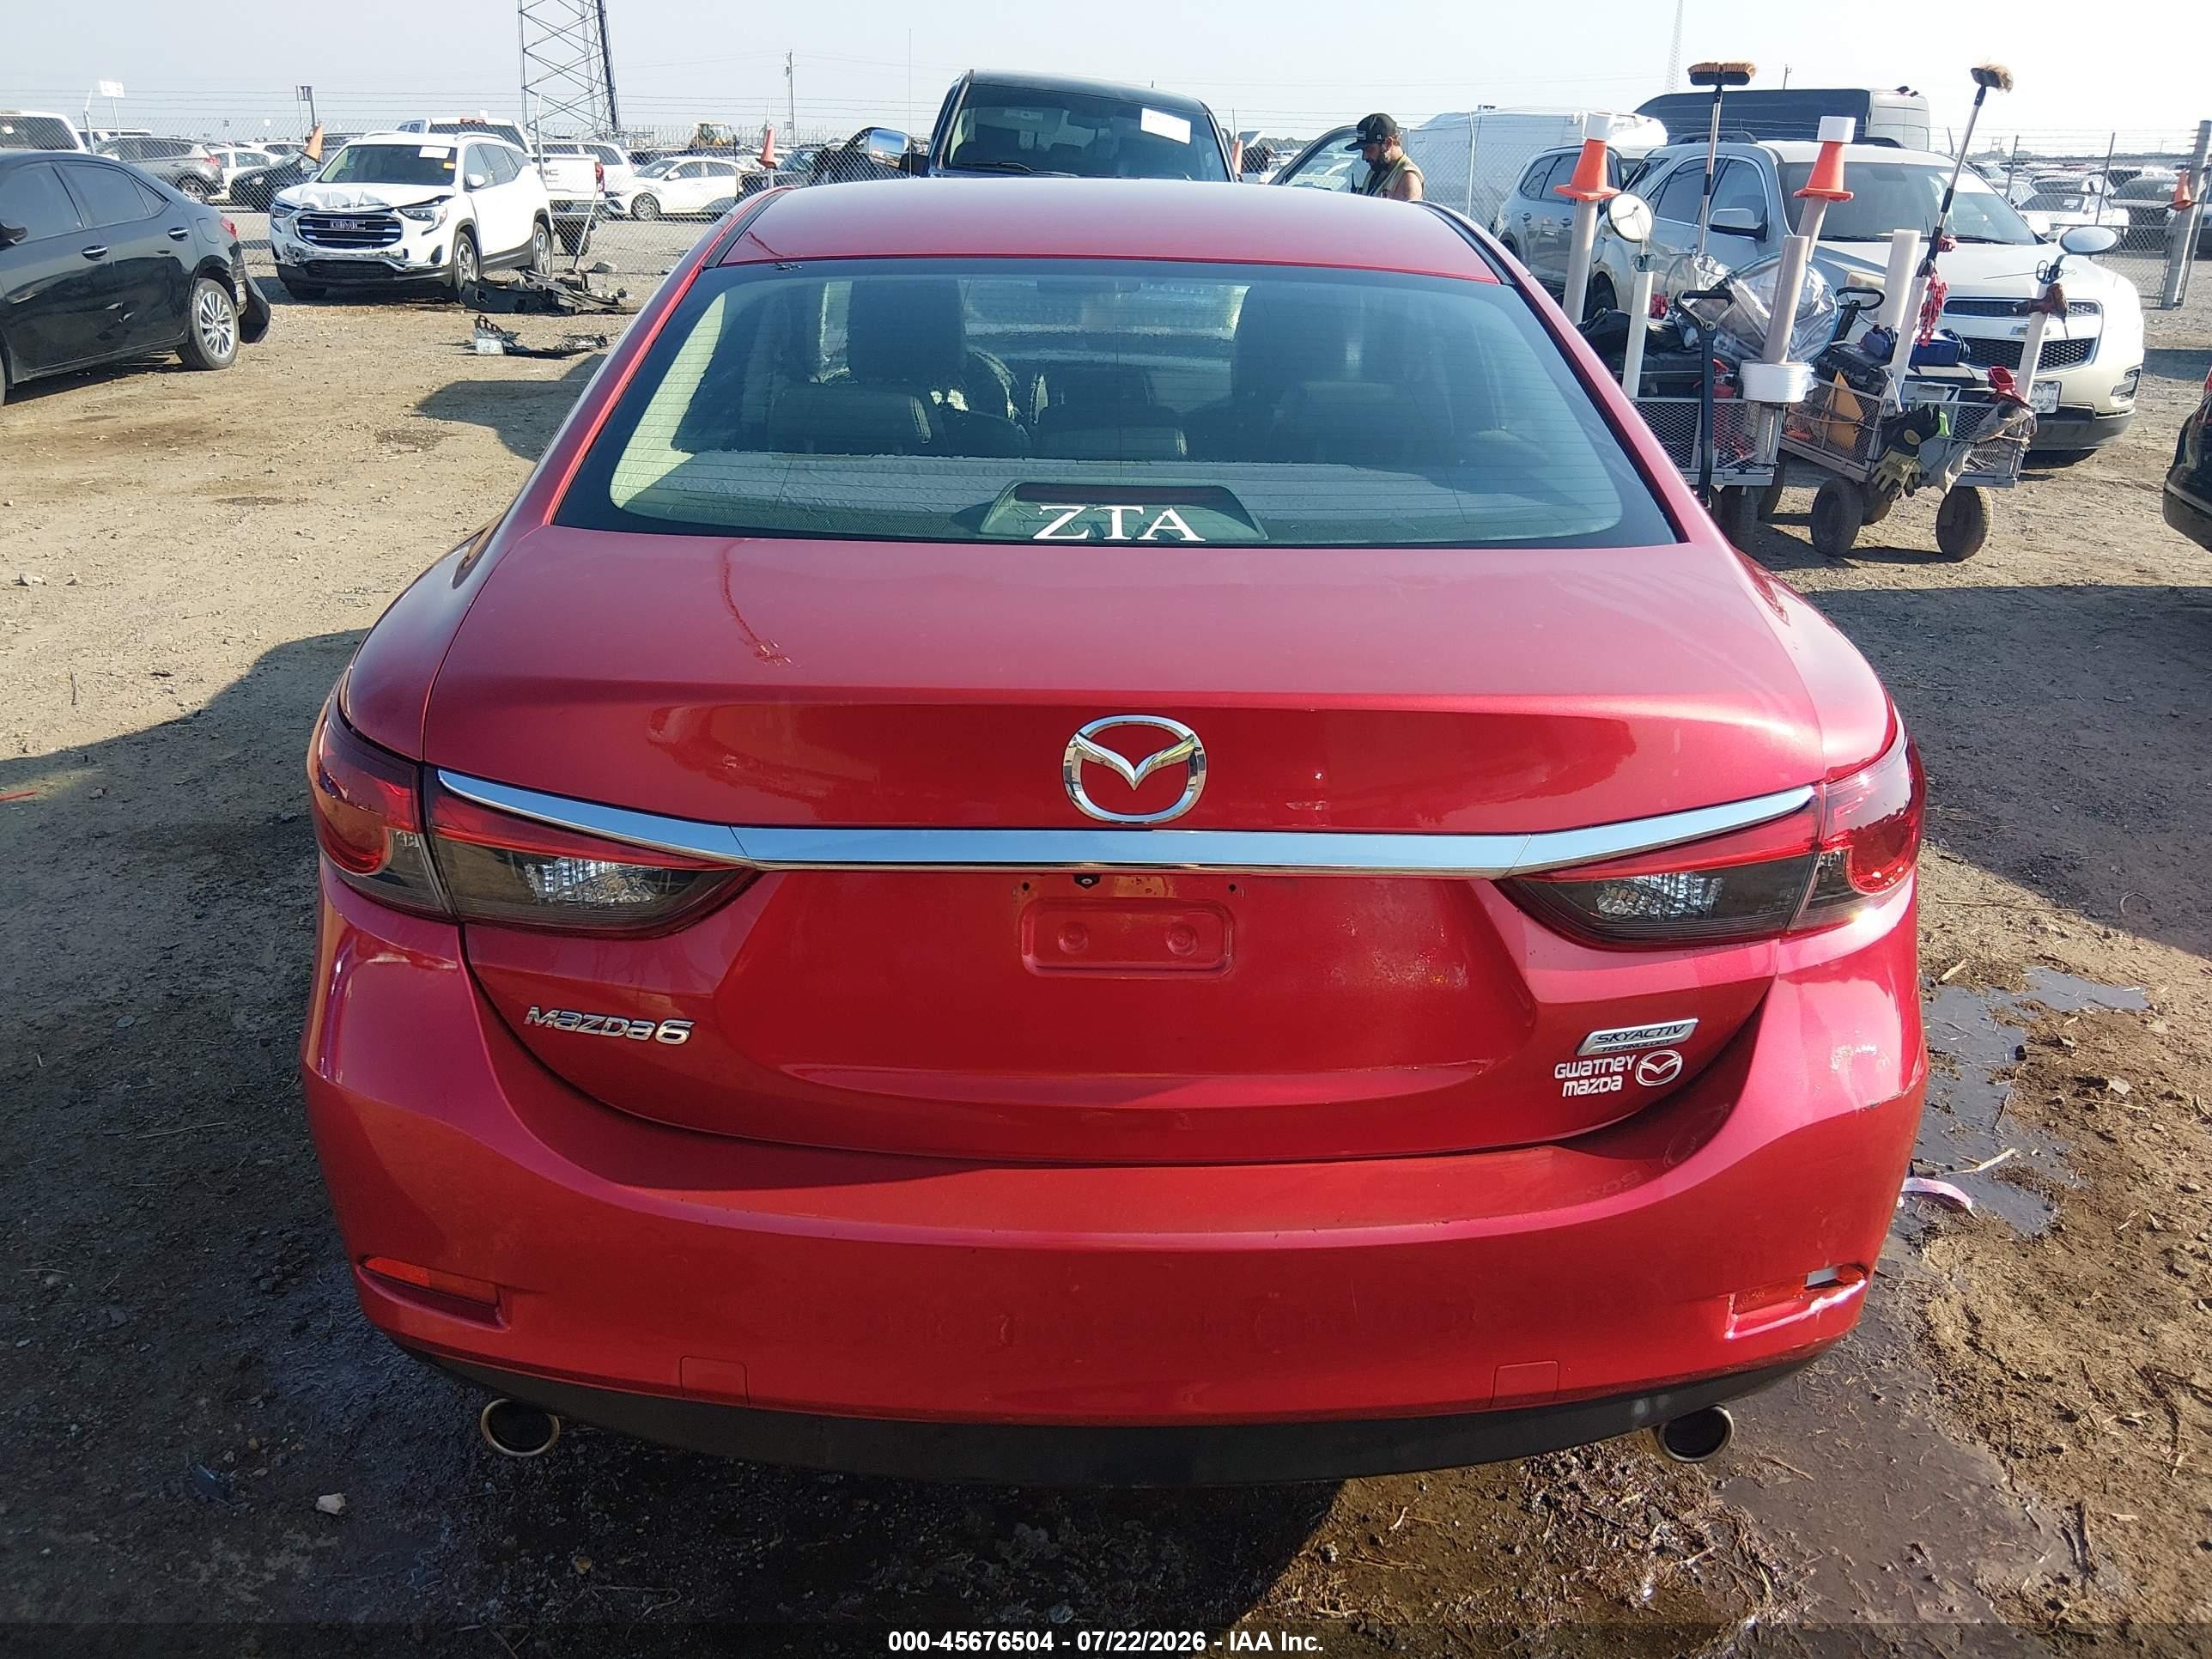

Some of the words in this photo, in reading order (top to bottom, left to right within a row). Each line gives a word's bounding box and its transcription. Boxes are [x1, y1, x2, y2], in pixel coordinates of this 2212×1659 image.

[330, 219, 366, 230] GMC
[1033, 505, 1206, 541] ZTA
[1595, 1024, 1686, 1043] SKYACTIV
[1601, 1039, 1670, 1052] TECHNOLOGY
